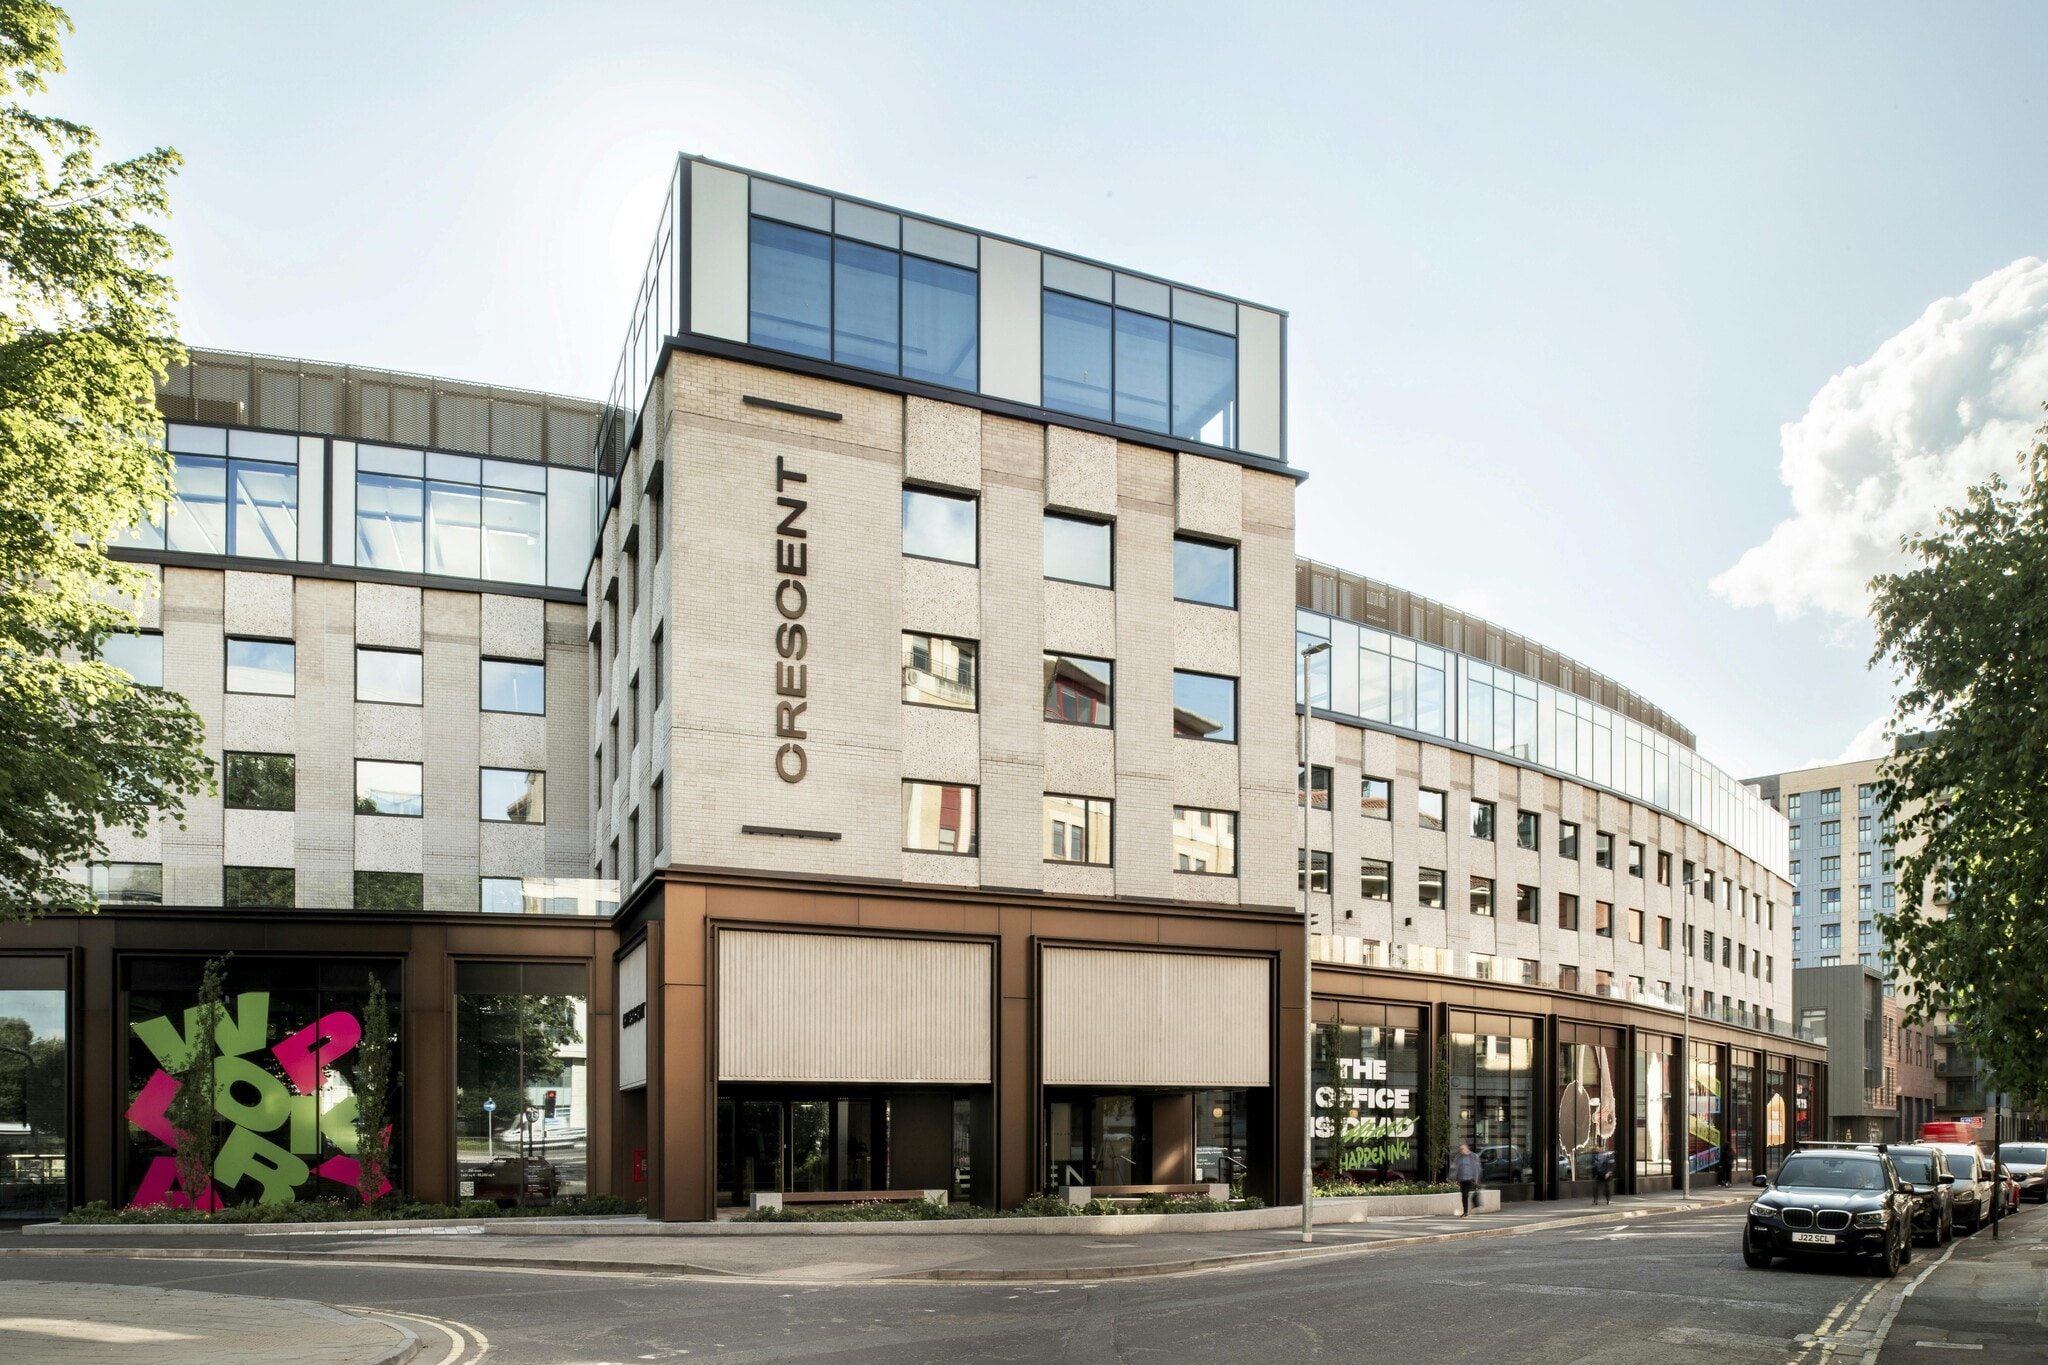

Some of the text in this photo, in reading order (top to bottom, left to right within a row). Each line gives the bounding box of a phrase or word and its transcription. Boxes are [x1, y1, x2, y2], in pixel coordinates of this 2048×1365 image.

[776, 455, 808, 784] CRESCENT
[1336, 1057, 1387, 1081] THE
[1315, 1086, 1410, 1109] OFFICE
[1310, 1116, 1335, 1138] IS
[1339, 1138, 1411, 1174] HAPPENING!
